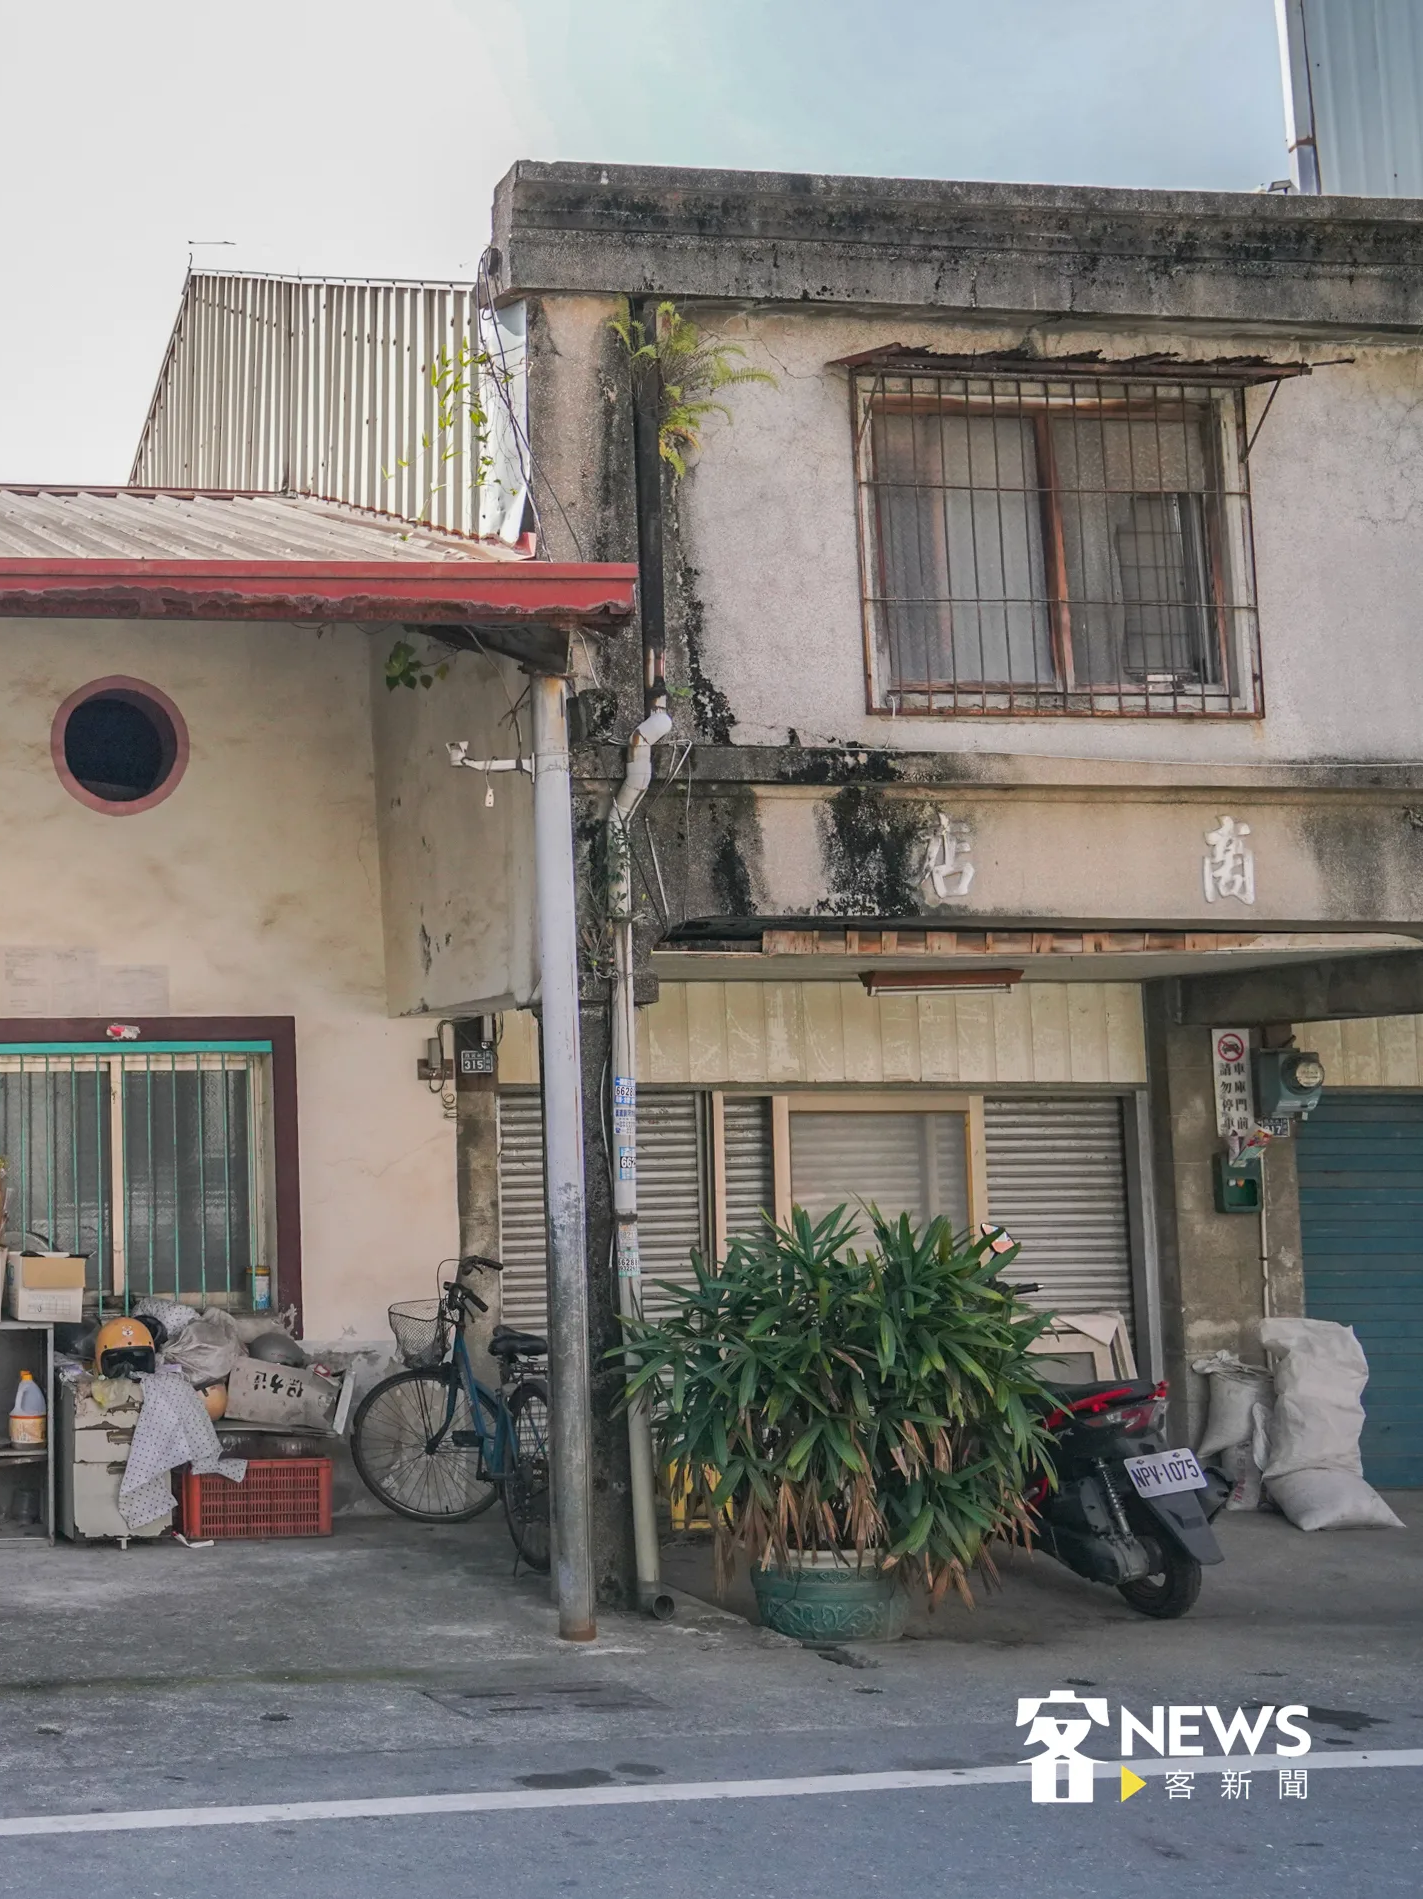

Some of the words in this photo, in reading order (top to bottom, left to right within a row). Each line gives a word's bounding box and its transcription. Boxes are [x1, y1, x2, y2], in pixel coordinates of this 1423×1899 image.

[464, 1060, 484, 1070] 315
[1219, 1062, 1235, 1130] 請勿停車
[1234, 1062, 1249, 1130] 車庫門前
